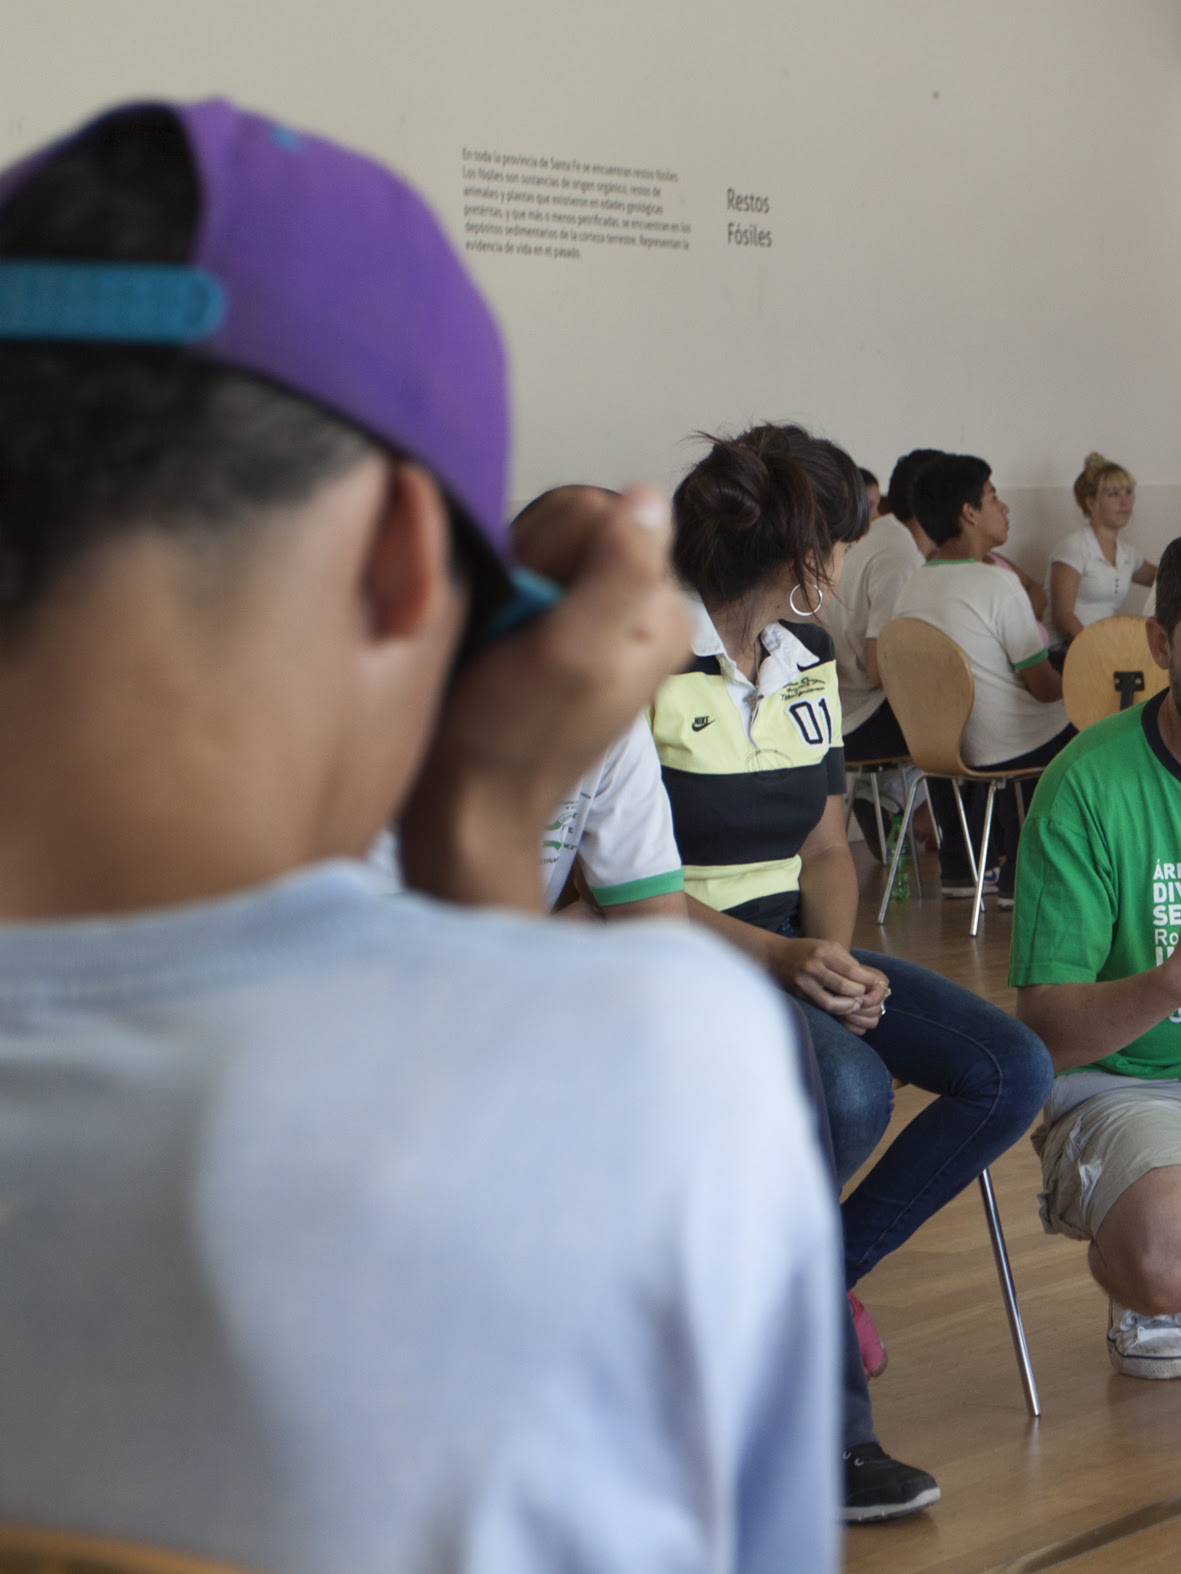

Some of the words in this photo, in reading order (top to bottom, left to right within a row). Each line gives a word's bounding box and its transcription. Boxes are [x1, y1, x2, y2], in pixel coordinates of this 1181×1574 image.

[462, 148, 472, 161] En
[474, 150, 491, 163] toda
[502, 155, 538, 168] provincia
[539, 156, 548, 169] de
[550, 157, 570, 171] Santa
[505, 173, 520, 183] son
[561, 176, 570, 188] de
[464, 186, 498, 199] animales
[506, 189, 534, 203] plantas
[536, 194, 550, 206] que
[726, 186, 770, 214] Restos
[512, 210, 526, 221] que
[560, 228, 569, 240] de
[727, 221, 773, 248] Fósiles
[466, 239, 504, 253] evidencia
[504, 241, 514, 253] de
[533, 247, 544, 255] en
[694, 715, 710, 725] NIKE
[789, 698, 831, 745] 01
